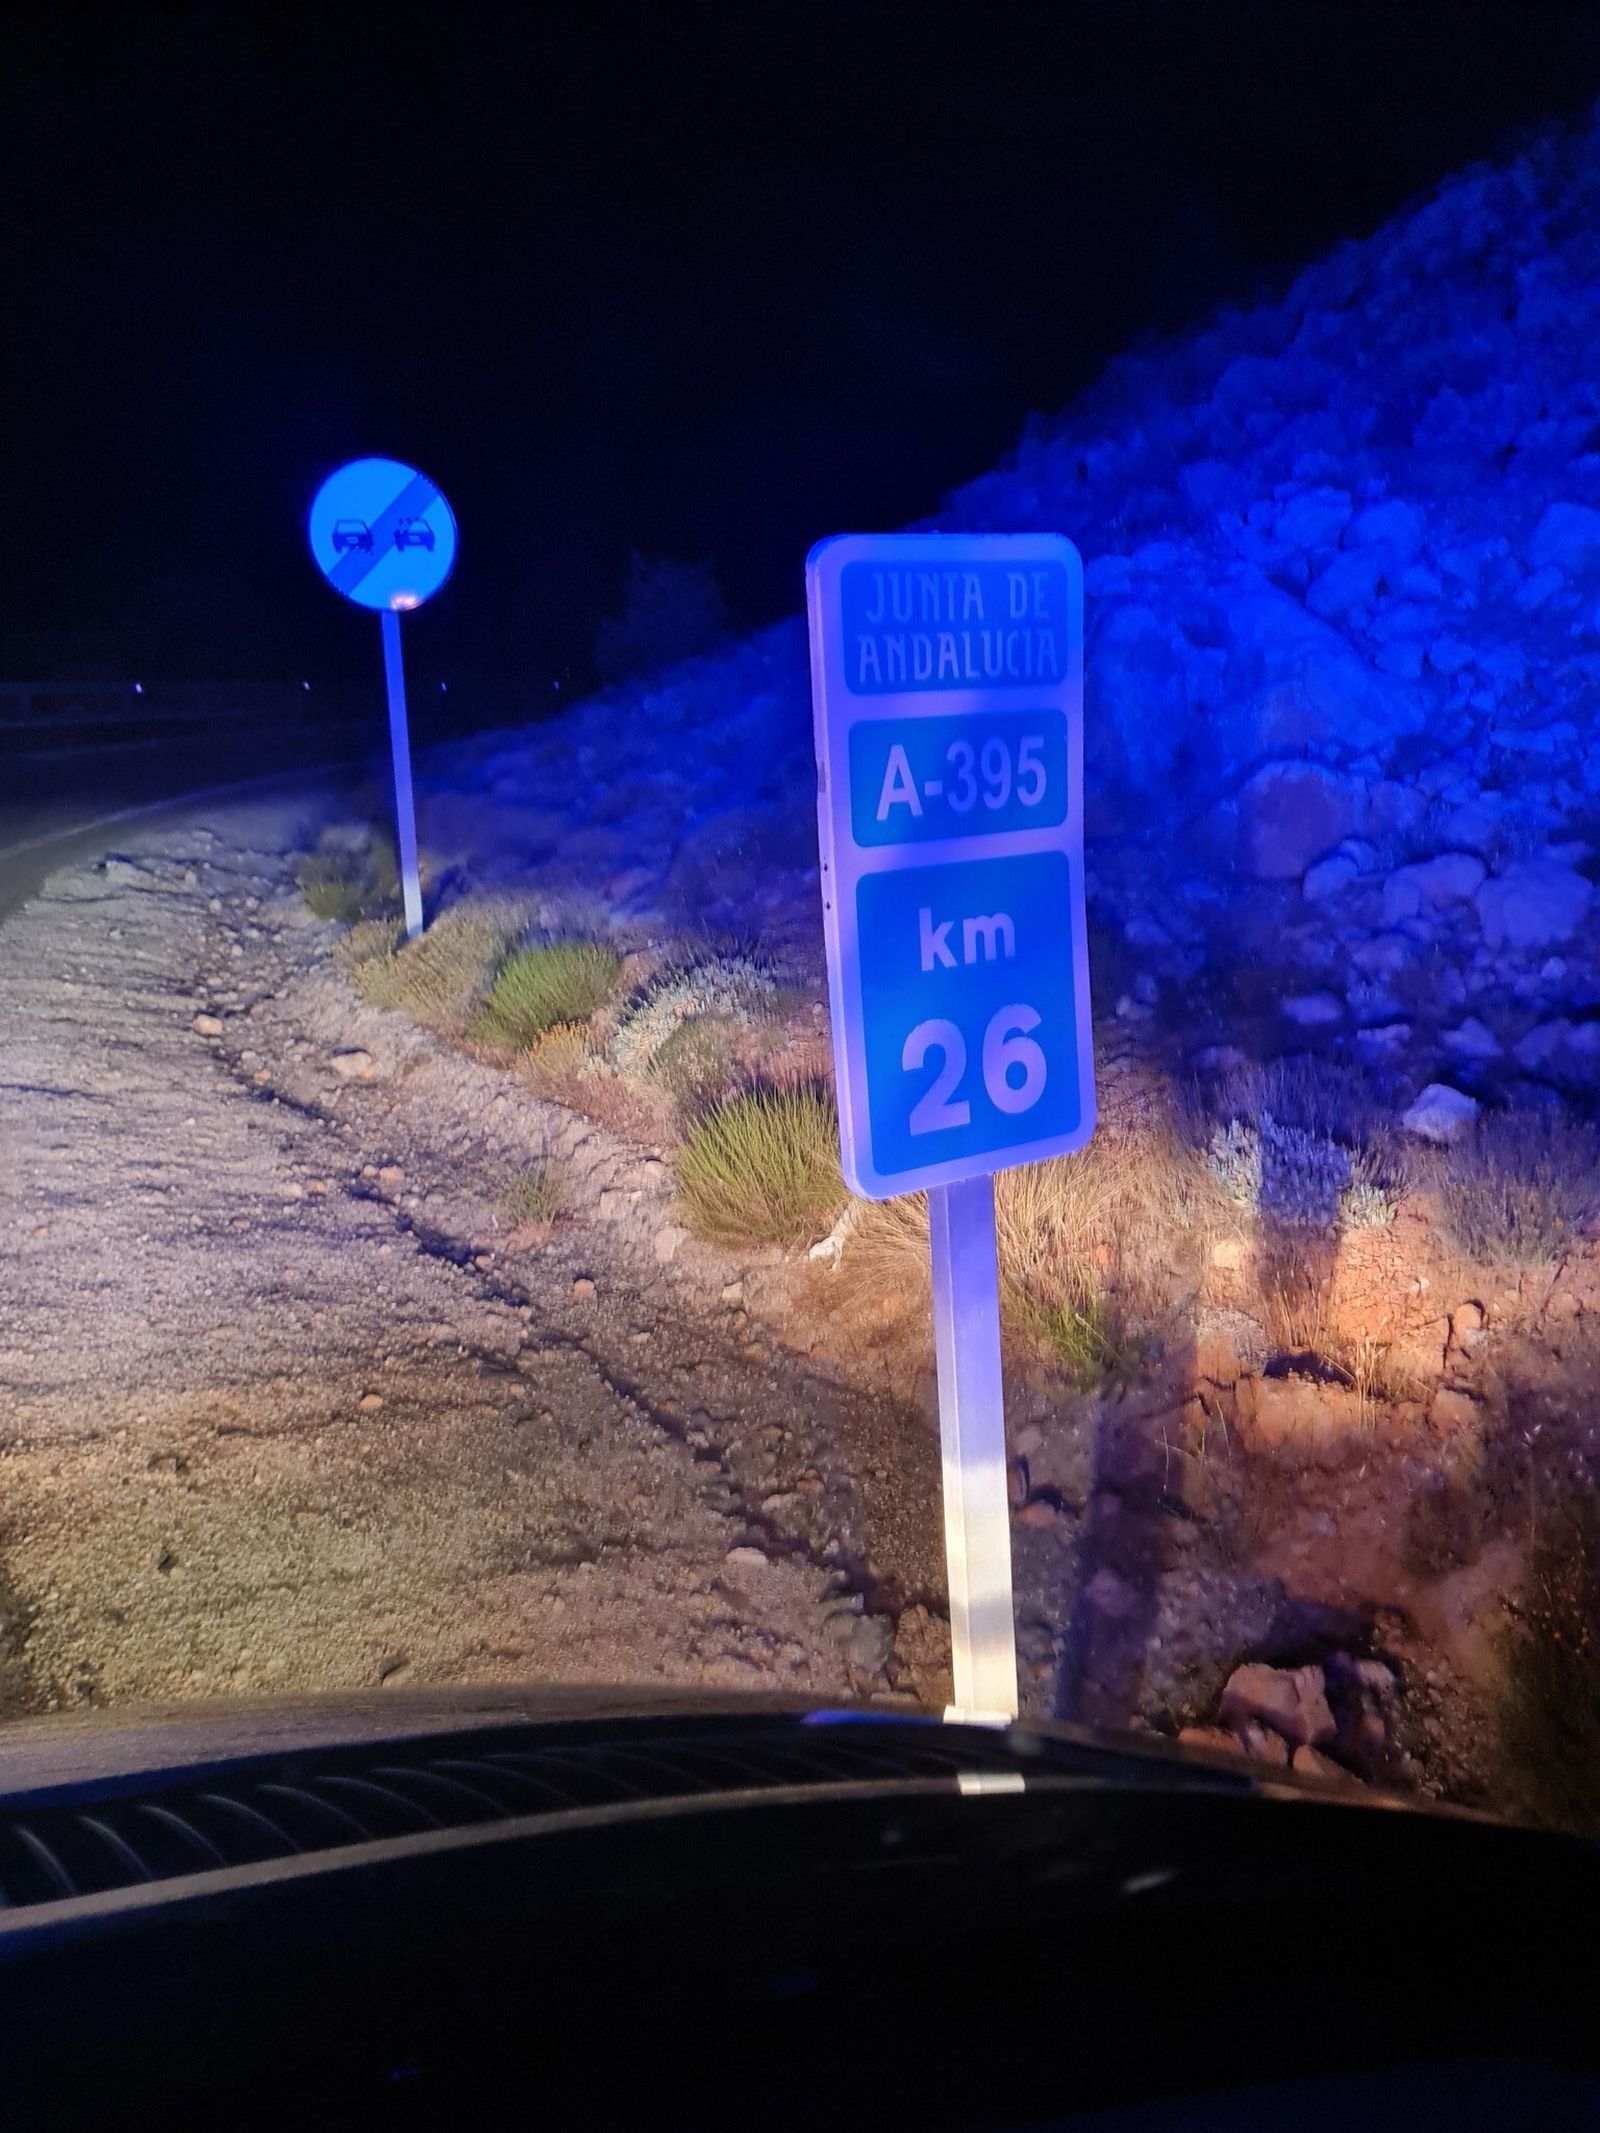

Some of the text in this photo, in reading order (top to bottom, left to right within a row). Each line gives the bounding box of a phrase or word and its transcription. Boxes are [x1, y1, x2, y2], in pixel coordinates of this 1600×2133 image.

[866, 570, 1050, 623] JUNTA DE
[857, 628, 1058, 682] ANDALUCIA
[876, 735, 1047, 821] A-395
[919, 907, 1015, 971] km
[902, 1003, 1047, 1136] 26
